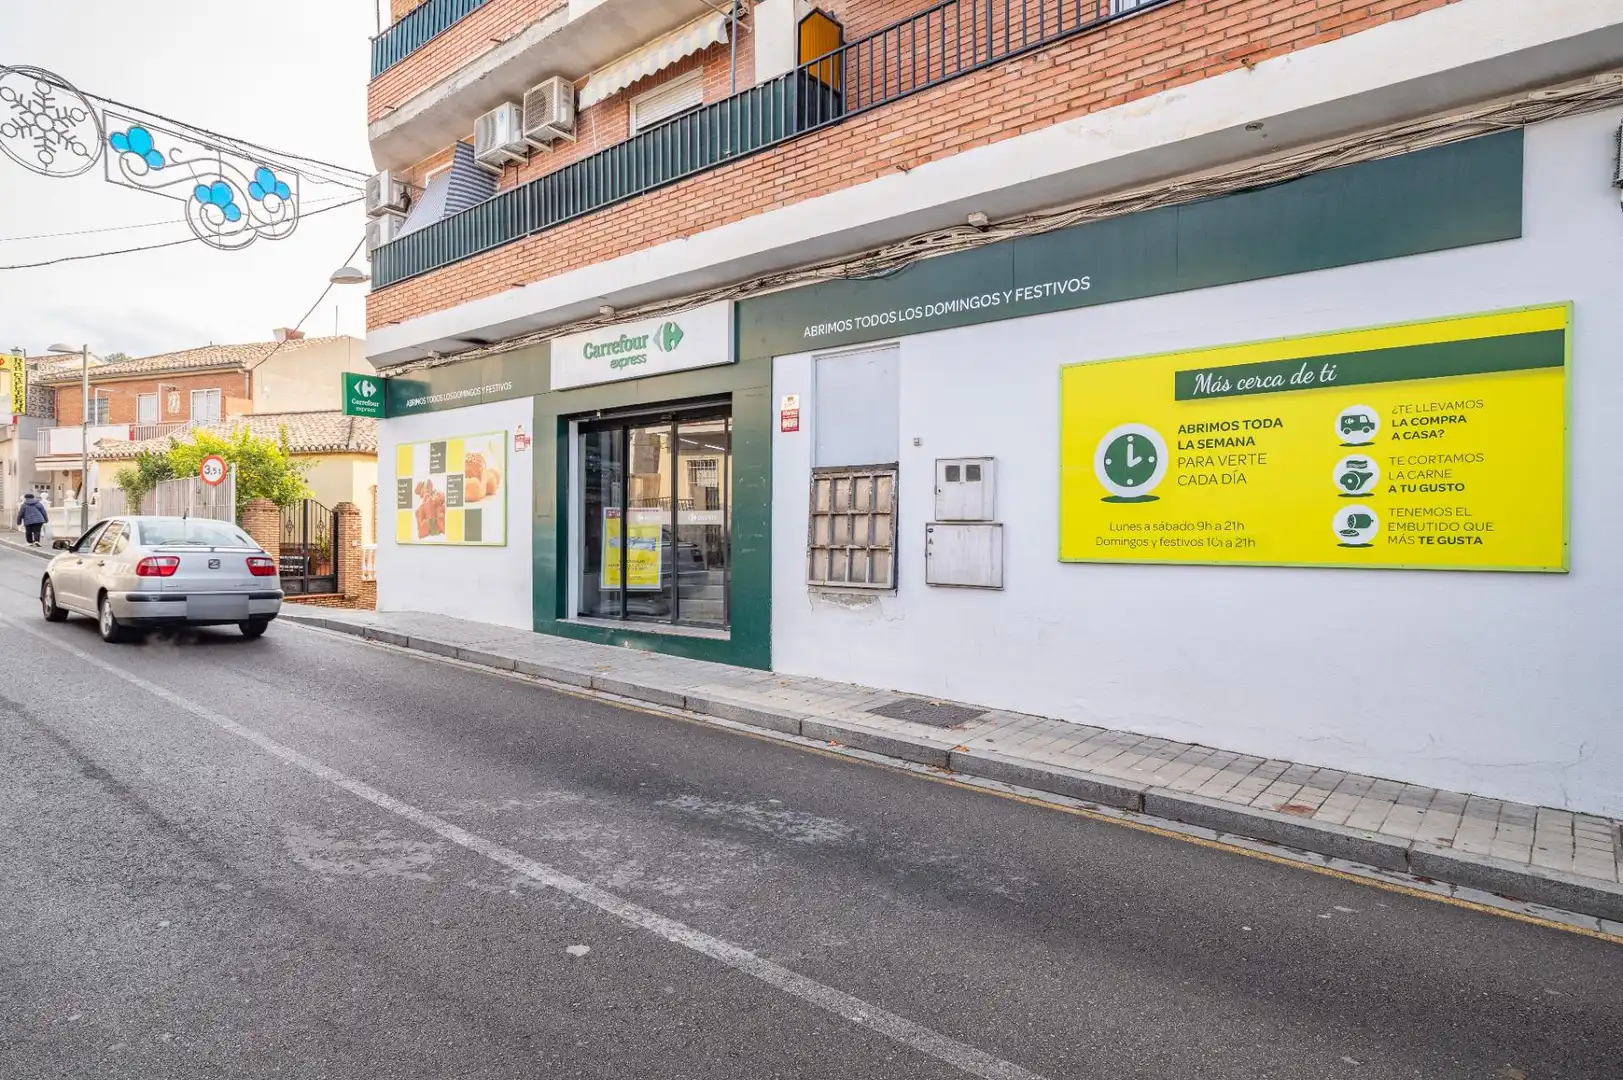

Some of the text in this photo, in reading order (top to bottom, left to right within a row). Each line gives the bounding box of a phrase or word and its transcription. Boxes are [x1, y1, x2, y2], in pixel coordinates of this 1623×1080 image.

[803, 276, 1091, 338] ABRIMOS TODOS LOS DOMINGOS Y FESTIVOS
[583, 334, 649, 360] Carrefour
[610, 353, 647, 370] express
[1193, 362, 1337, 396] Más cerca de ti
[406, 397, 427, 408] ABRIMOS
[427, 394, 444, 404] TODOS
[444, 392, 453, 401] LOS
[453, 386, 481, 400] DOMINGOS
[486, 381, 513, 394] FESTIVOS
[351, 397, 380, 408] Carrefour
[1391, 399, 1484, 415] ¿TE LLEVAMOS
[1178, 417, 1283, 434] ABRIMOS TODA
[1391, 415, 1467, 428] LA COMPRA
[1391, 429, 1445, 441] A CASA?
[1178, 436, 1256, 450] LA SEMANA
[1178, 452, 1267, 468] PARA VERTE
[1389, 452, 1484, 466] TE CORTAMOS
[1177, 470, 1247, 486] CADA DÍA
[1388, 469, 1453, 481] LA CARNE
[1388, 482, 1465, 493] A TU GUSTO
[1388, 506, 1472, 517] TENEMOS EL
[1109, 520, 1245, 532] Lunes a sábado 9h a 21h
[1388, 521, 1494, 533] EMBUTIDO QUE
[1096, 536, 1149, 549] Domingos
[1151, 540, 1157, 548] y
[1159, 537, 1204, 548] festivos
[1225, 540, 1233, 548] a
[1235, 537, 1256, 548] 21h
[1388, 533, 1483, 545] MÁS TE GUSTA
